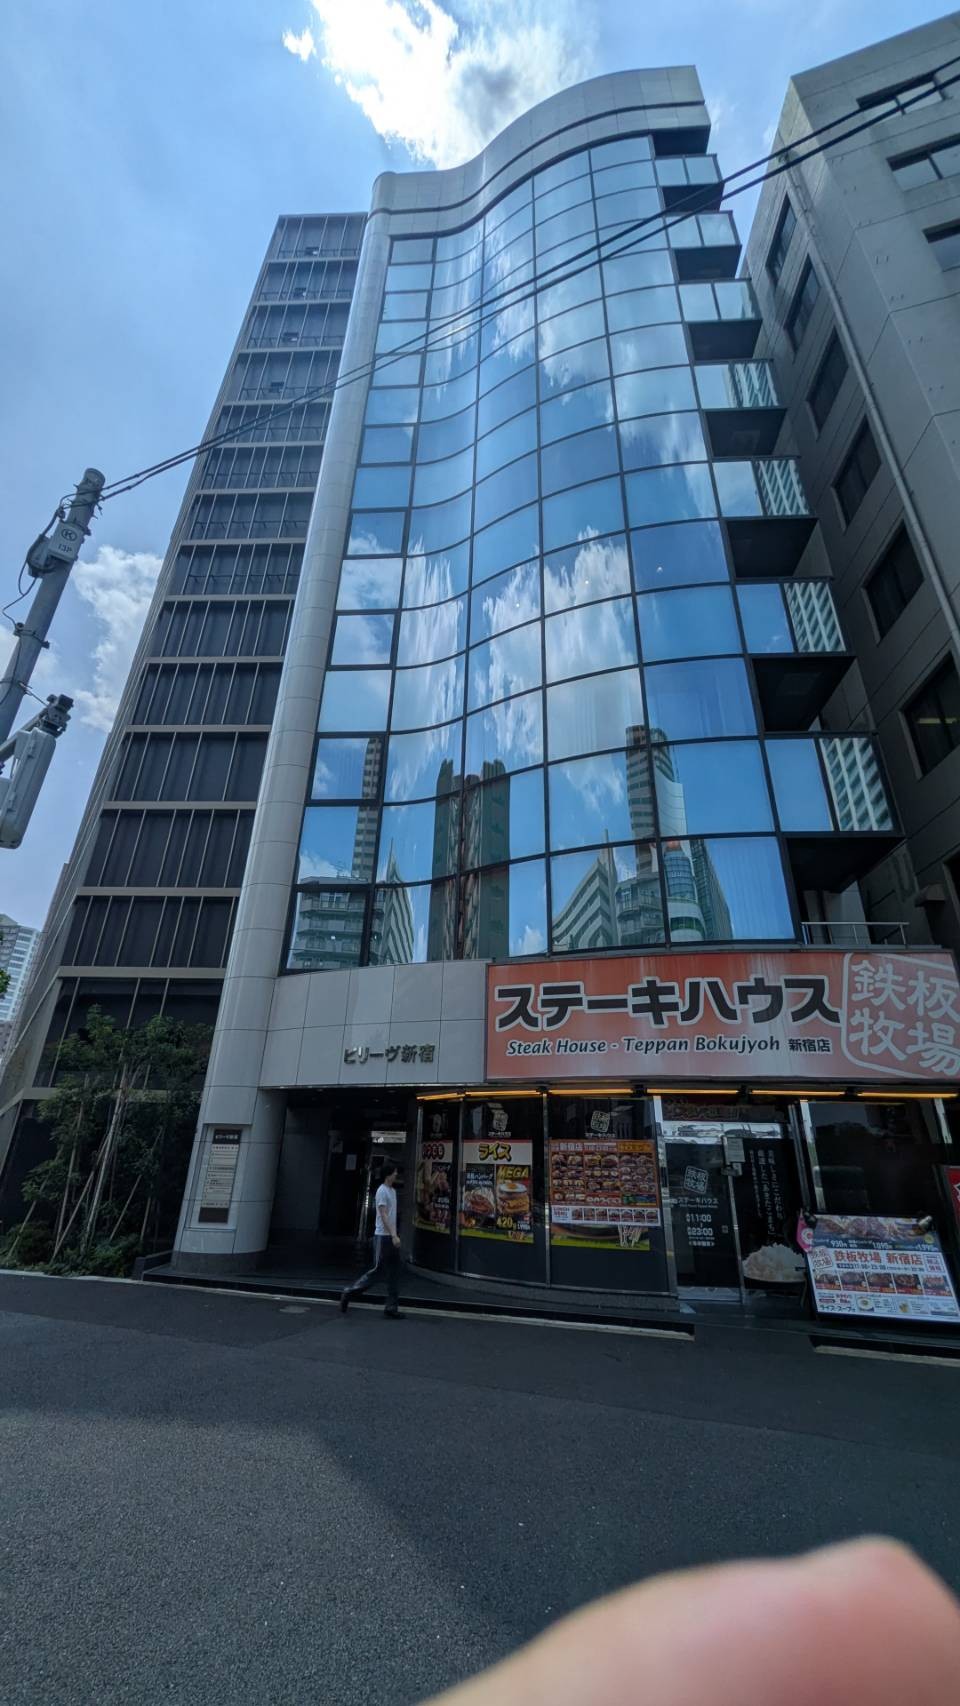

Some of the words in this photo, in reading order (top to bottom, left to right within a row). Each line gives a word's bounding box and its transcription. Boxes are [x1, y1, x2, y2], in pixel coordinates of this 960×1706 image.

[851, 960, 960, 1023] 鉄板
[496, 977, 841, 1029] ステーキハウス
[508, 1038, 551, 1055] Steak
[557, 1038, 606, 1053] House
[624, 1037, 689, 1054] Teppan
[696, 1036, 780, 1055] Bokujyoh
[788, 1039, 831, 1053] 新宿店
[849, 1007, 960, 1075] 牧場
[344, 1044, 435, 1064] ビリーヴ新宿
[479, 1142, 512, 1161] ライス
[498, 1165, 529, 1179] MEGA
